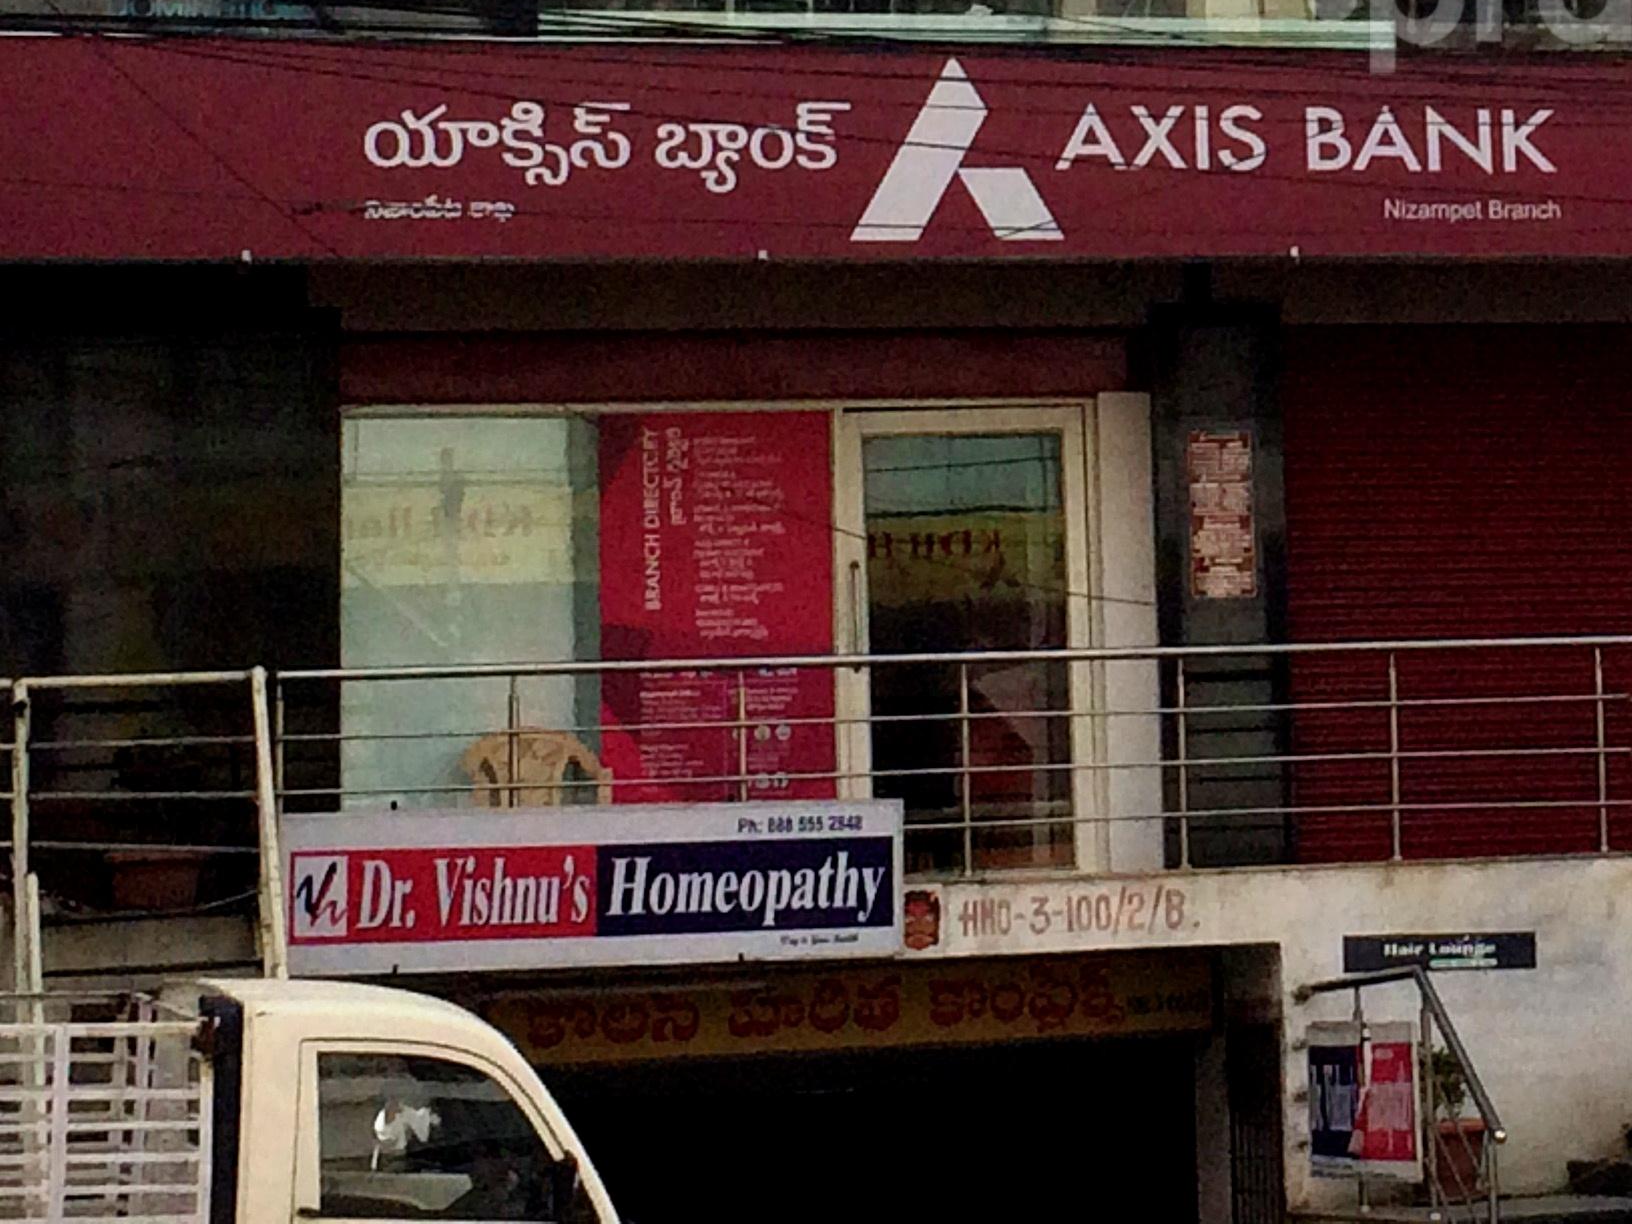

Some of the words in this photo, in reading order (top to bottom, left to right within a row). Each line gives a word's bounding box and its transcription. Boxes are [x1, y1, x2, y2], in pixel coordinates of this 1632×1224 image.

[1055, 102, 1268, 173] AXIS
[1306, 104, 1557, 176] BANK
[1384, 197, 1483, 223] Nizampet
[1488, 198, 1562, 220] Branch
[641, 425, 661, 529] DIRECTORY
[644, 534, 662, 610] BRANCH
[355, 860, 416, 930] Dr.
[433, 854, 590, 929] Vishnu's
[604, 850, 887, 927] Homeopathy
[1383, 941, 1425, 957] Hair
[1428, 940, 1497, 958] Lounge
